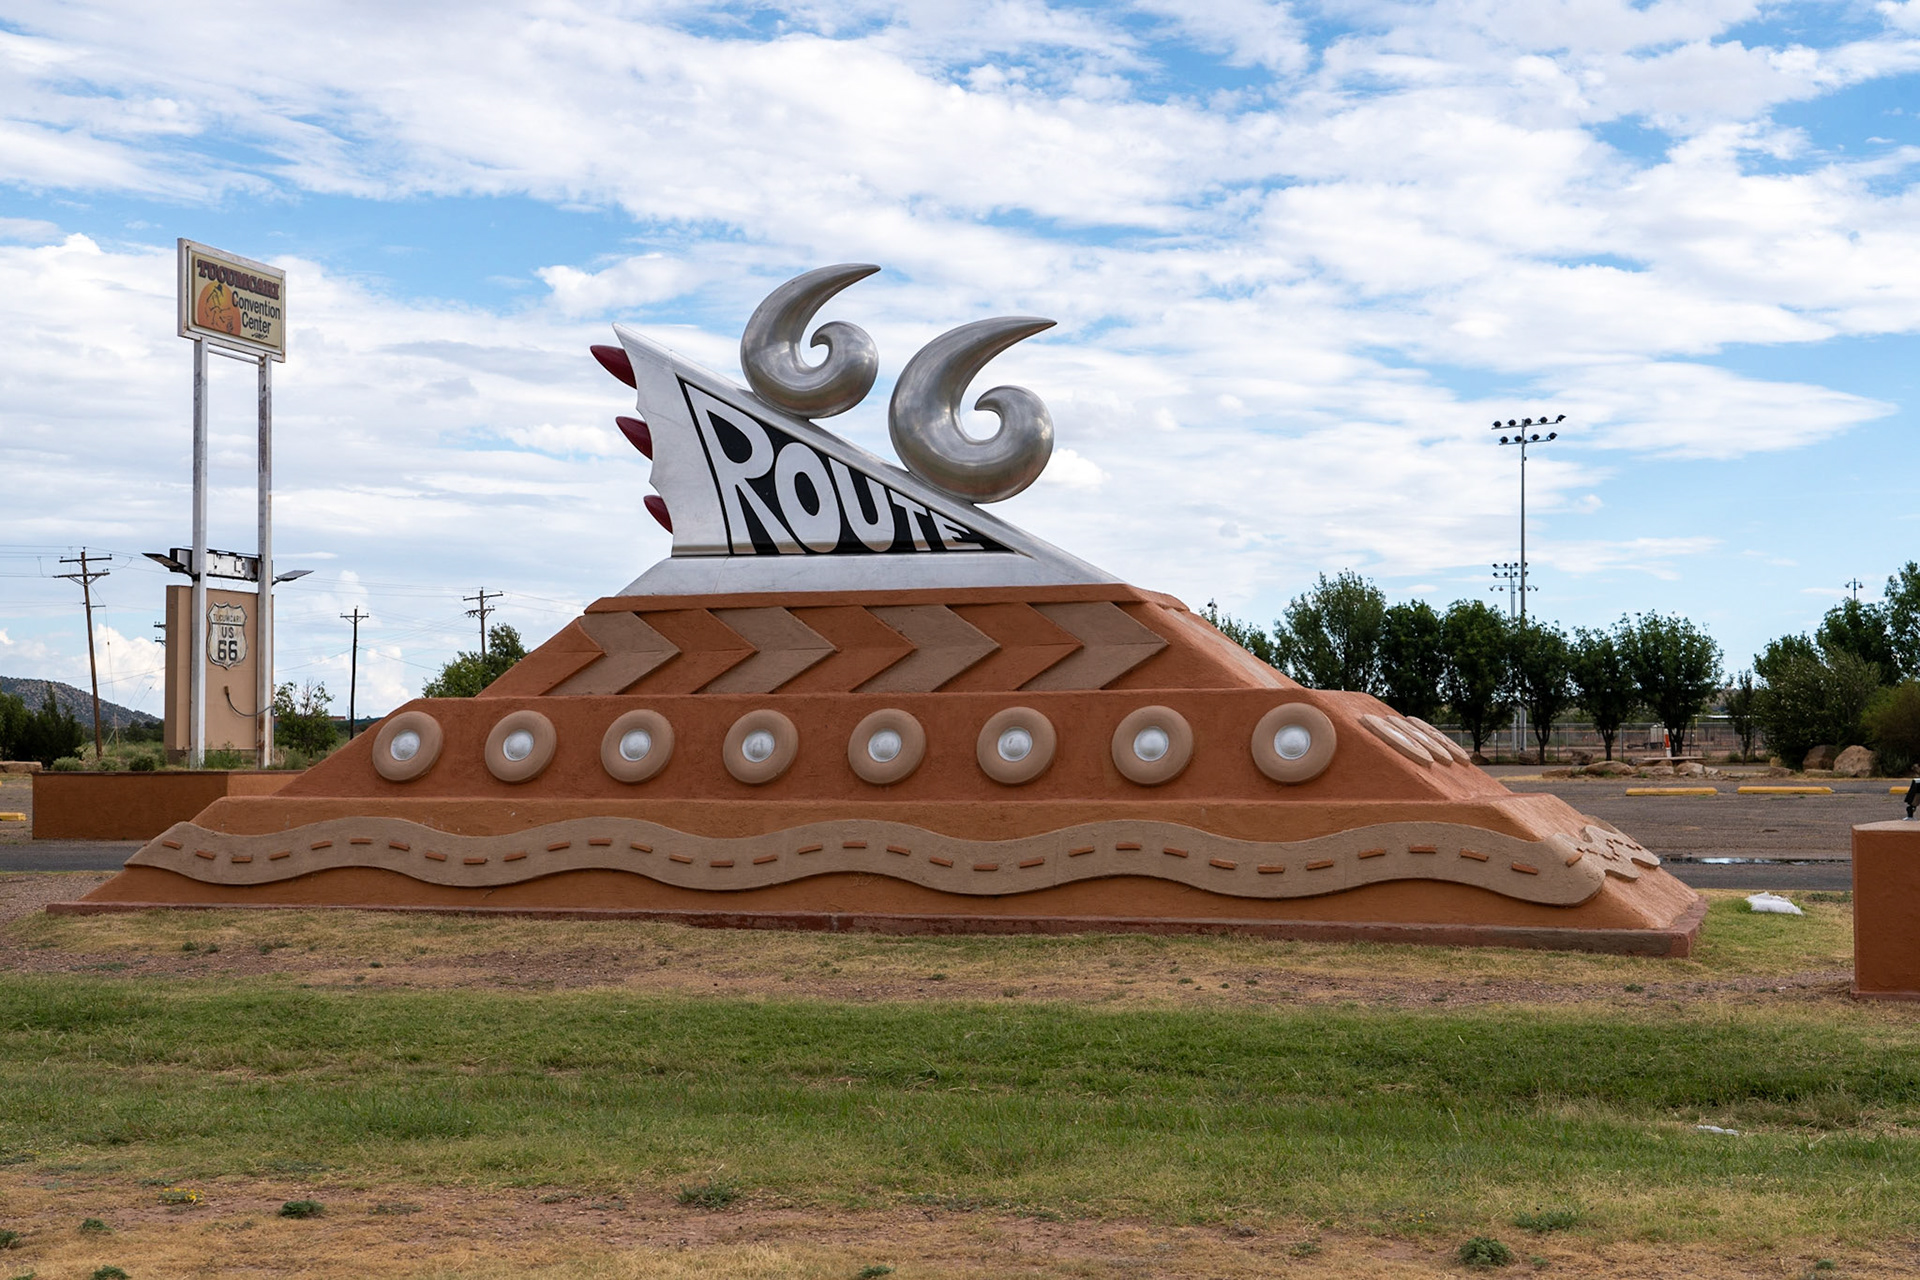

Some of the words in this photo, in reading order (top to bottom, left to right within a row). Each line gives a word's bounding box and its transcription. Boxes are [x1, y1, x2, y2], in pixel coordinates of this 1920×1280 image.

[197, 259, 279, 300] TUCUMCARI
[232, 291, 281, 320] Convention
[242, 312, 271, 334] Center
[741, 263, 1056, 502] 66
[682, 381, 985, 555] ROUTE
[221, 626, 234, 639] US
[218, 640, 238, 661] 66
